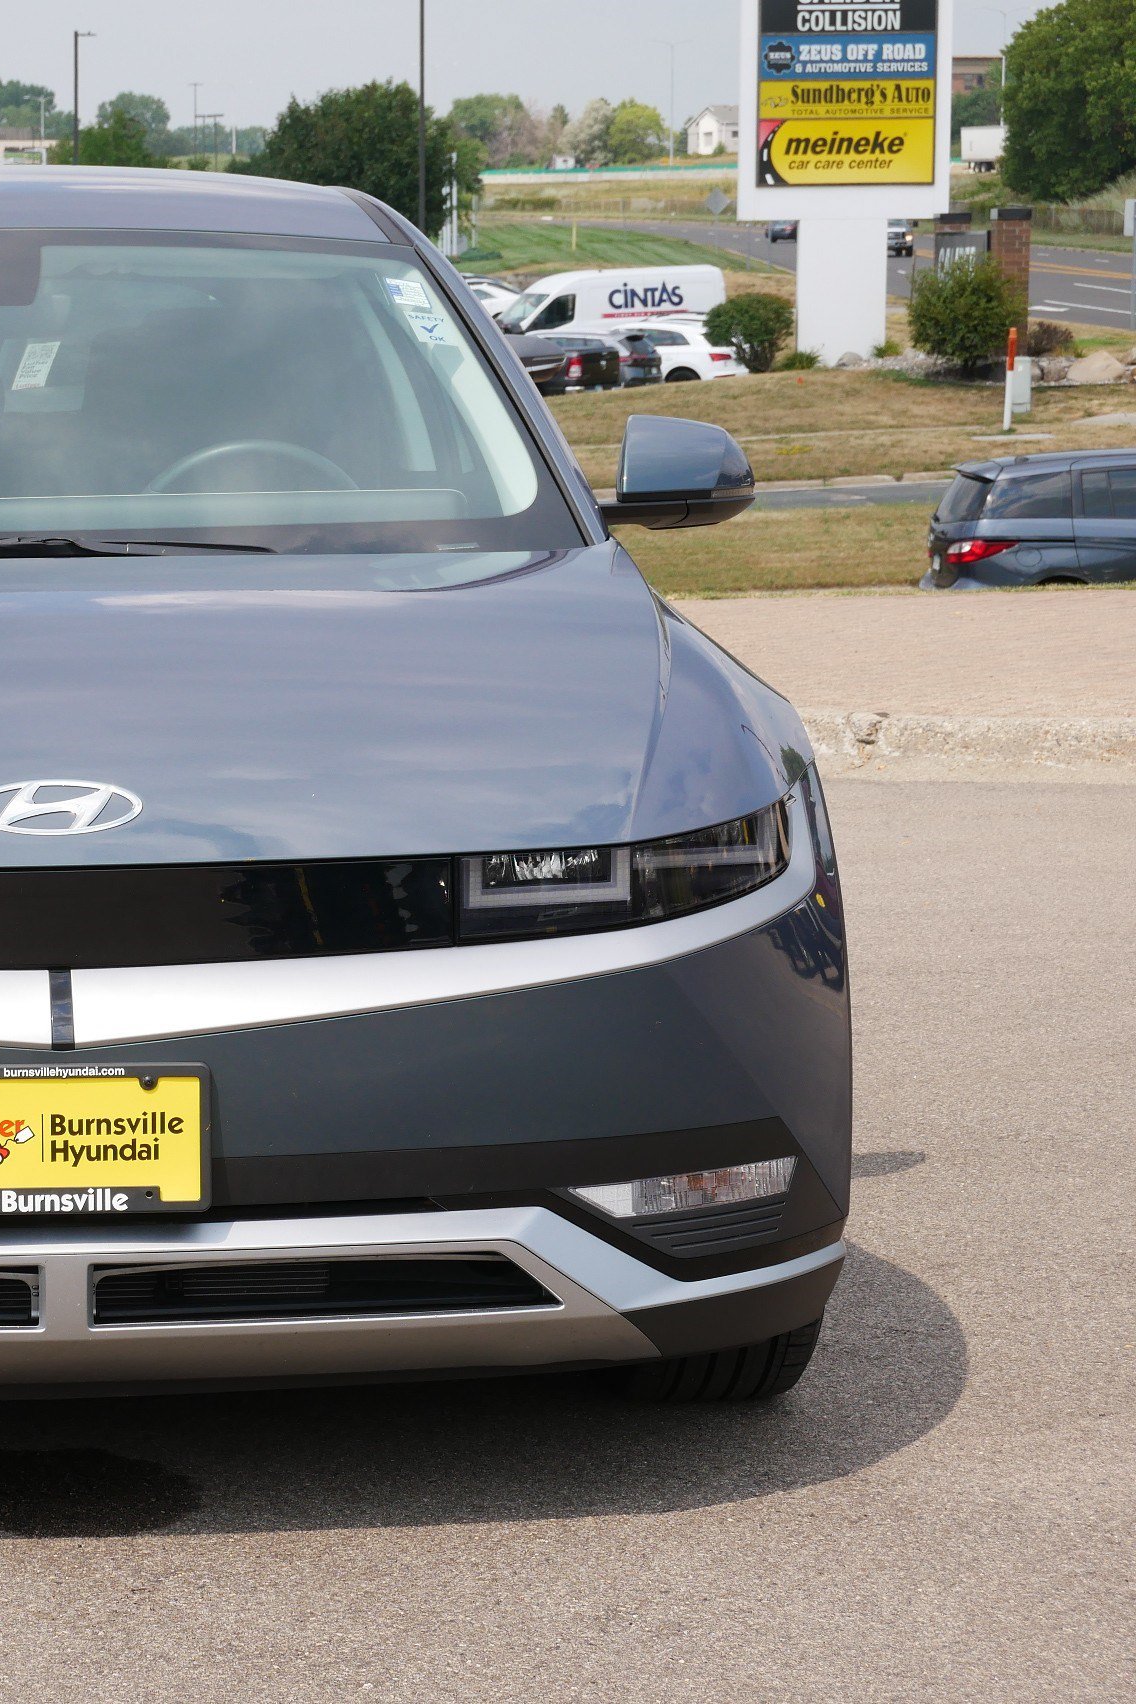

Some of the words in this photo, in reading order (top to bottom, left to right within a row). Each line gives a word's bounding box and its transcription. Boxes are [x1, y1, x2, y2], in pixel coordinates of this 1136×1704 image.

[797, 10, 901, 31] COLLISION
[798, 44, 843, 61] ZEUS
[846, 43, 879, 60] OFF
[882, 43, 926, 60] ROAD
[794, 63, 803, 73] &
[805, 62, 874, 73] AUTOMOTIVE
[876, 62, 929, 72] SERVICES
[790, 83, 887, 107] Sundberg's
[790, 108, 820, 116] TOTAL
[889, 107, 930, 115] SERVICE
[784, 131, 905, 156] meineke
[788, 160, 811, 170] car
[814, 158, 844, 170] care
[848, 157, 894, 170] center
[407, 313, 445, 323] SAFETY
[3, 1066, 125, 1078] burnsvillehyundai.com
[49, 1110, 185, 1136] Burnsville
[49, 1137, 161, 1167] Hyundai
[1, 1188, 129, 1213] Burnsville
